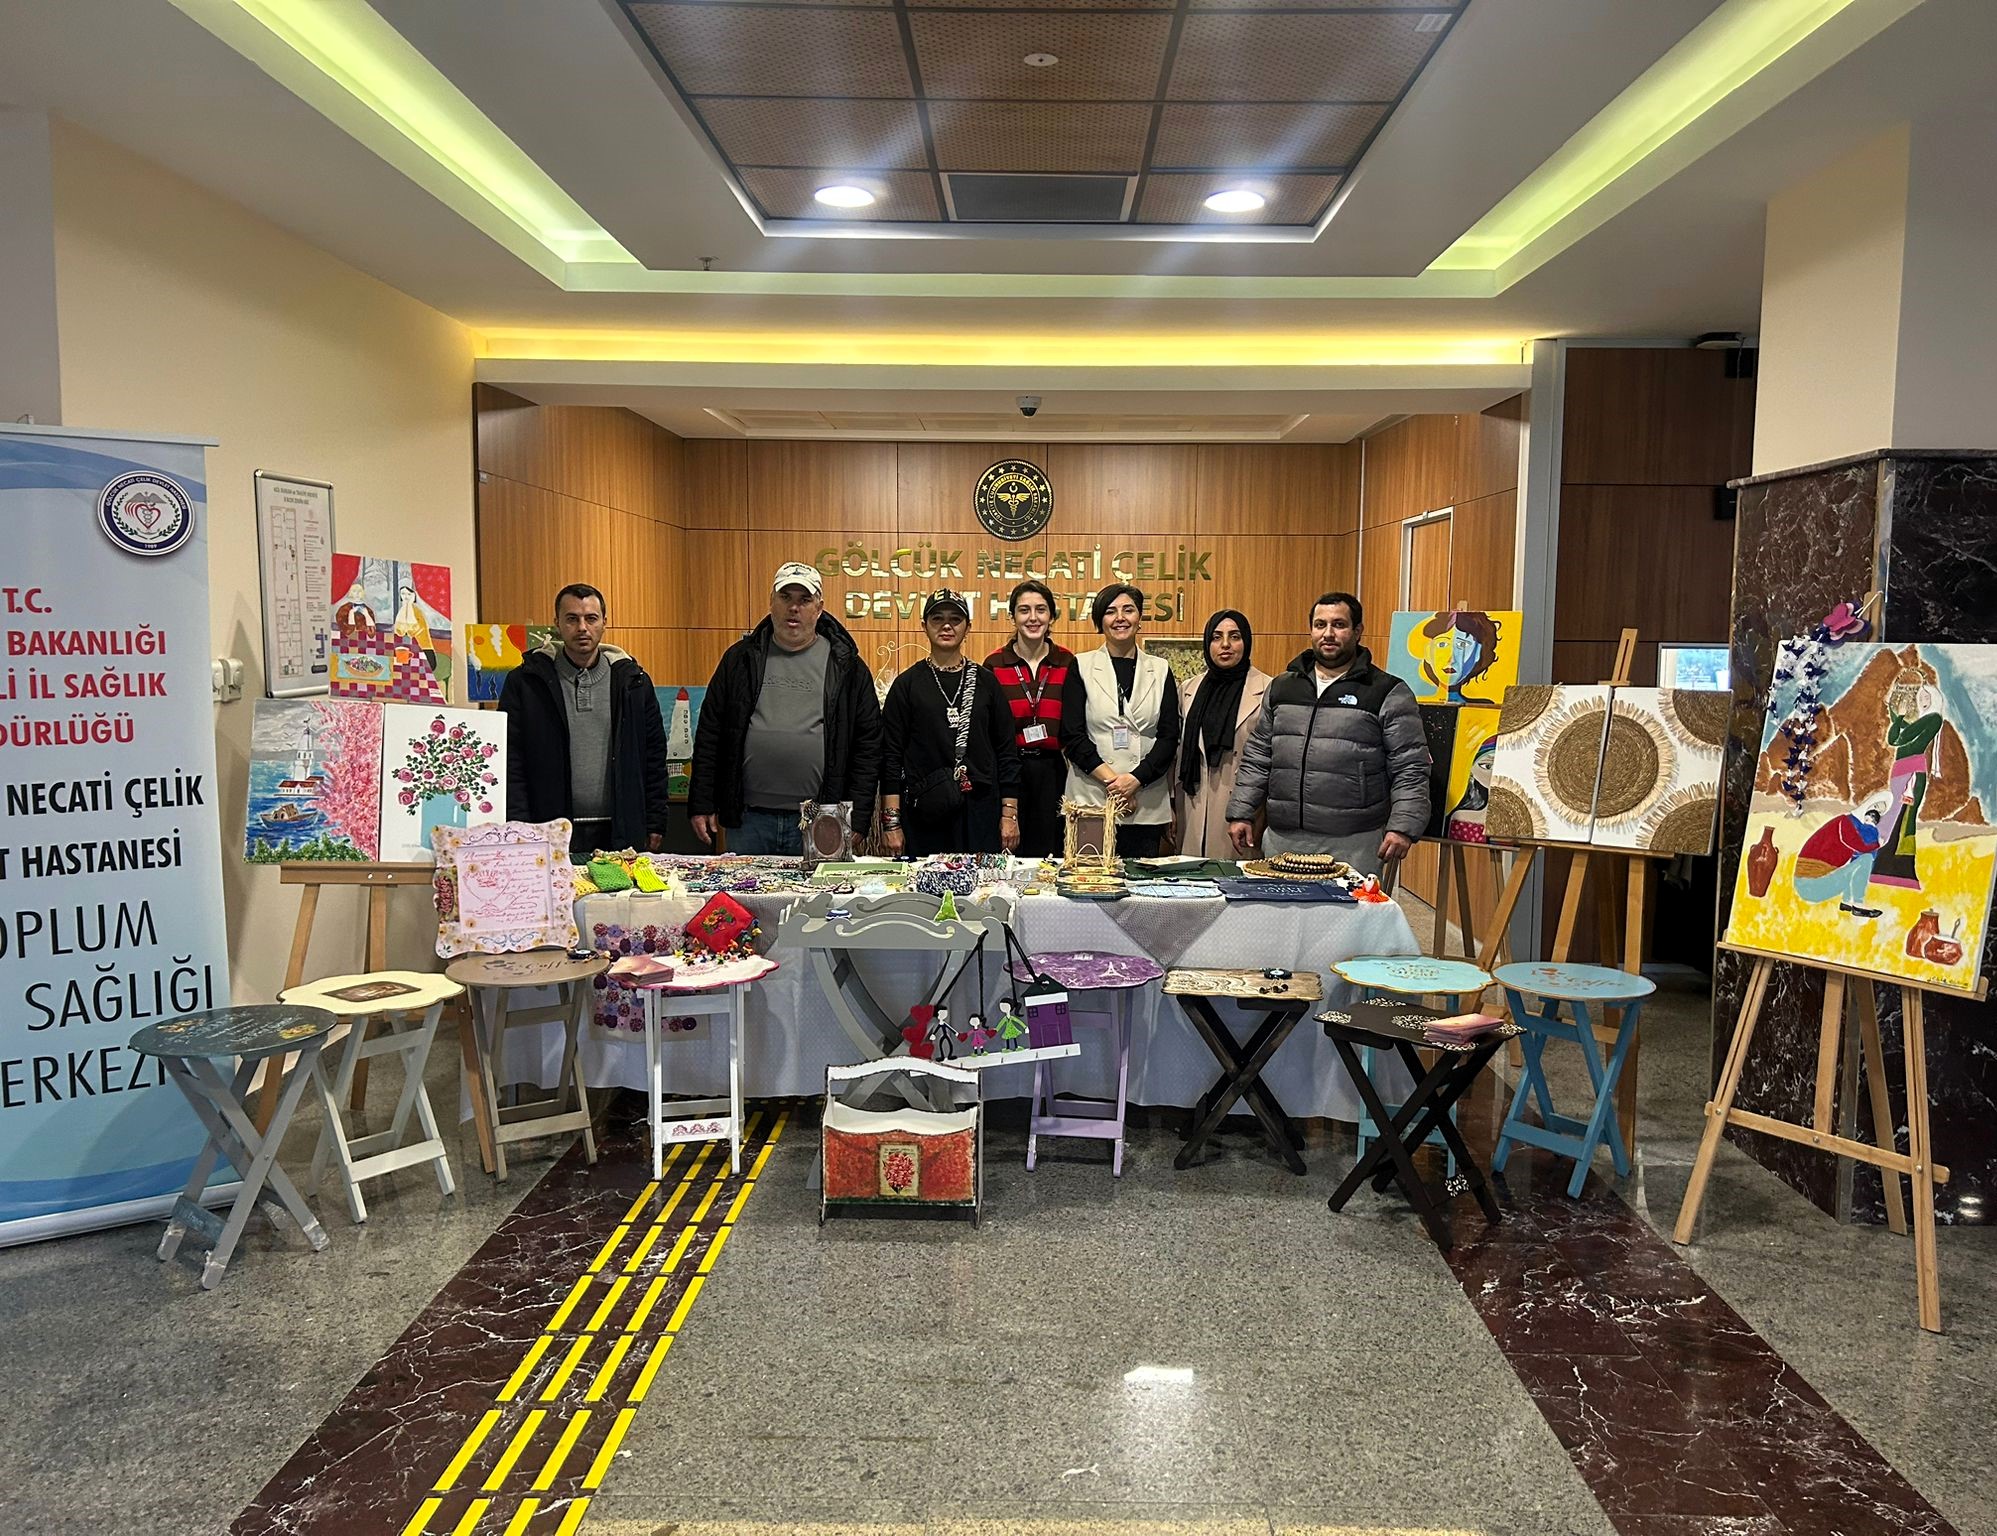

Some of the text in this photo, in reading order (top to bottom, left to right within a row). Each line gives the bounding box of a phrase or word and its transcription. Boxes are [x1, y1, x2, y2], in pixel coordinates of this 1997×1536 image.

[815, 541, 1212, 584] GÖLCÜK NECATİ ÇELİK
[2, 588, 52, 613] T.C.
[7, 623, 167, 656] BAKANLIĞI
[29, 667, 55, 699] İL
[64, 666, 167, 699] SAĞLIK
[7, 767, 204, 818] NECATİ ÇELİK
[22, 828, 182, 878] HASTANESİ
[0, 900, 158, 960] PLUM
[25, 954, 214, 1031] SAĞLIĞI
